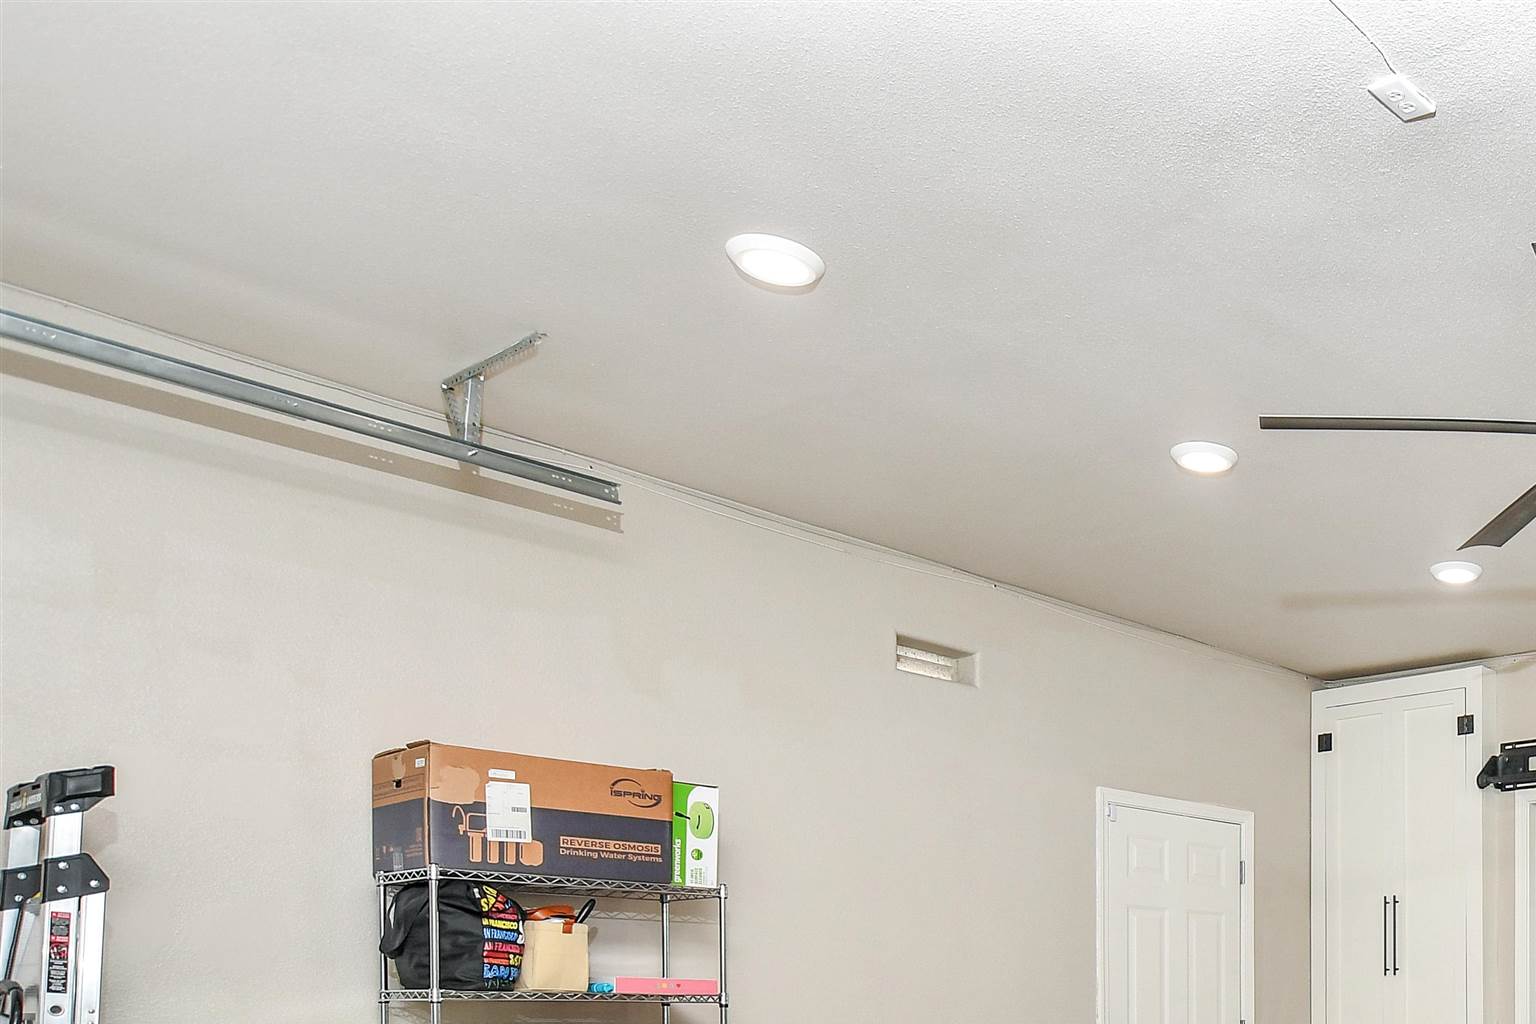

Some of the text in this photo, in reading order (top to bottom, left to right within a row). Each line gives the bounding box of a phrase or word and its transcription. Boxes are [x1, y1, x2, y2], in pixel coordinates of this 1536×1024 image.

[561, 837, 661, 854] REVERSE OSMOSIS
[559, 848, 663, 863] Drinking Water Systems
[672, 838, 682, 883] greenworks
